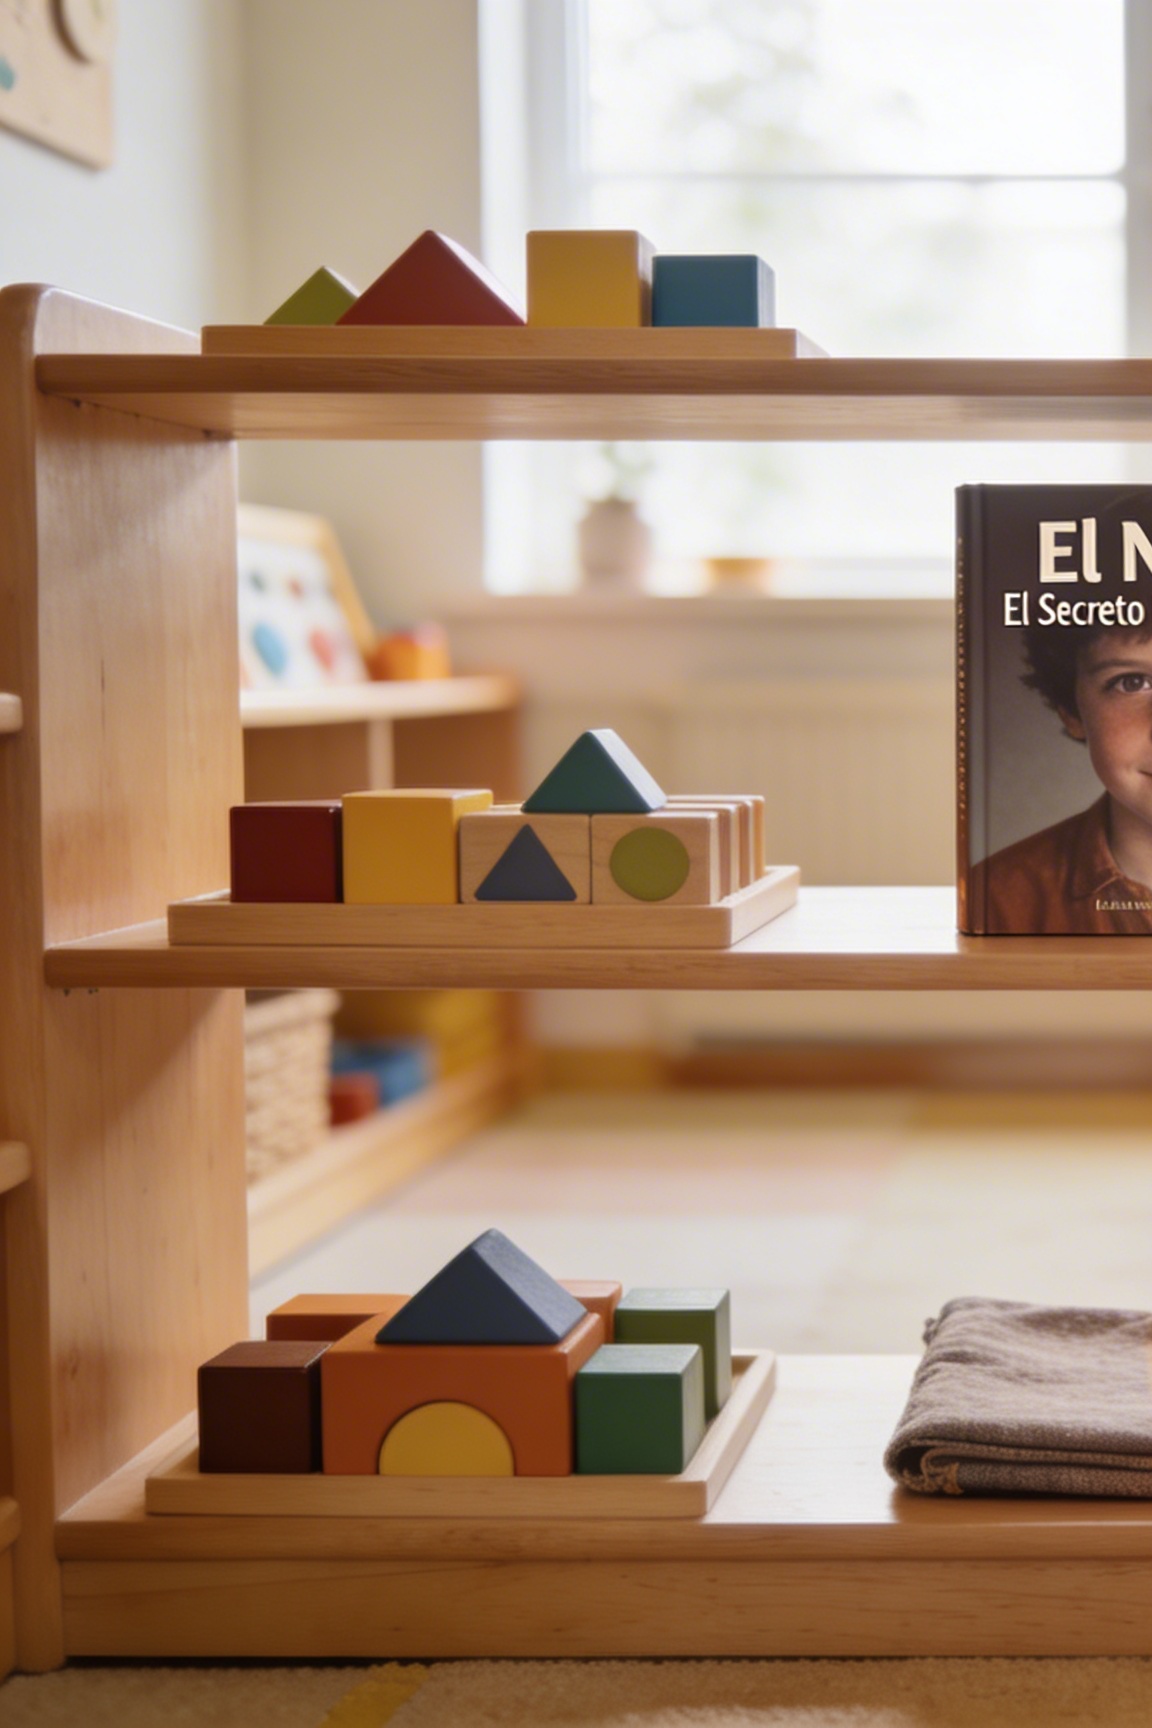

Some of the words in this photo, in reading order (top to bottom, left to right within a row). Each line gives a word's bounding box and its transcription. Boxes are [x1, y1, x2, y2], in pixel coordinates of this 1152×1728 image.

[1039, 517, 1102, 583] El
[1004, 592, 1030, 627] El
[1038, 592, 1145, 627] Secreto
